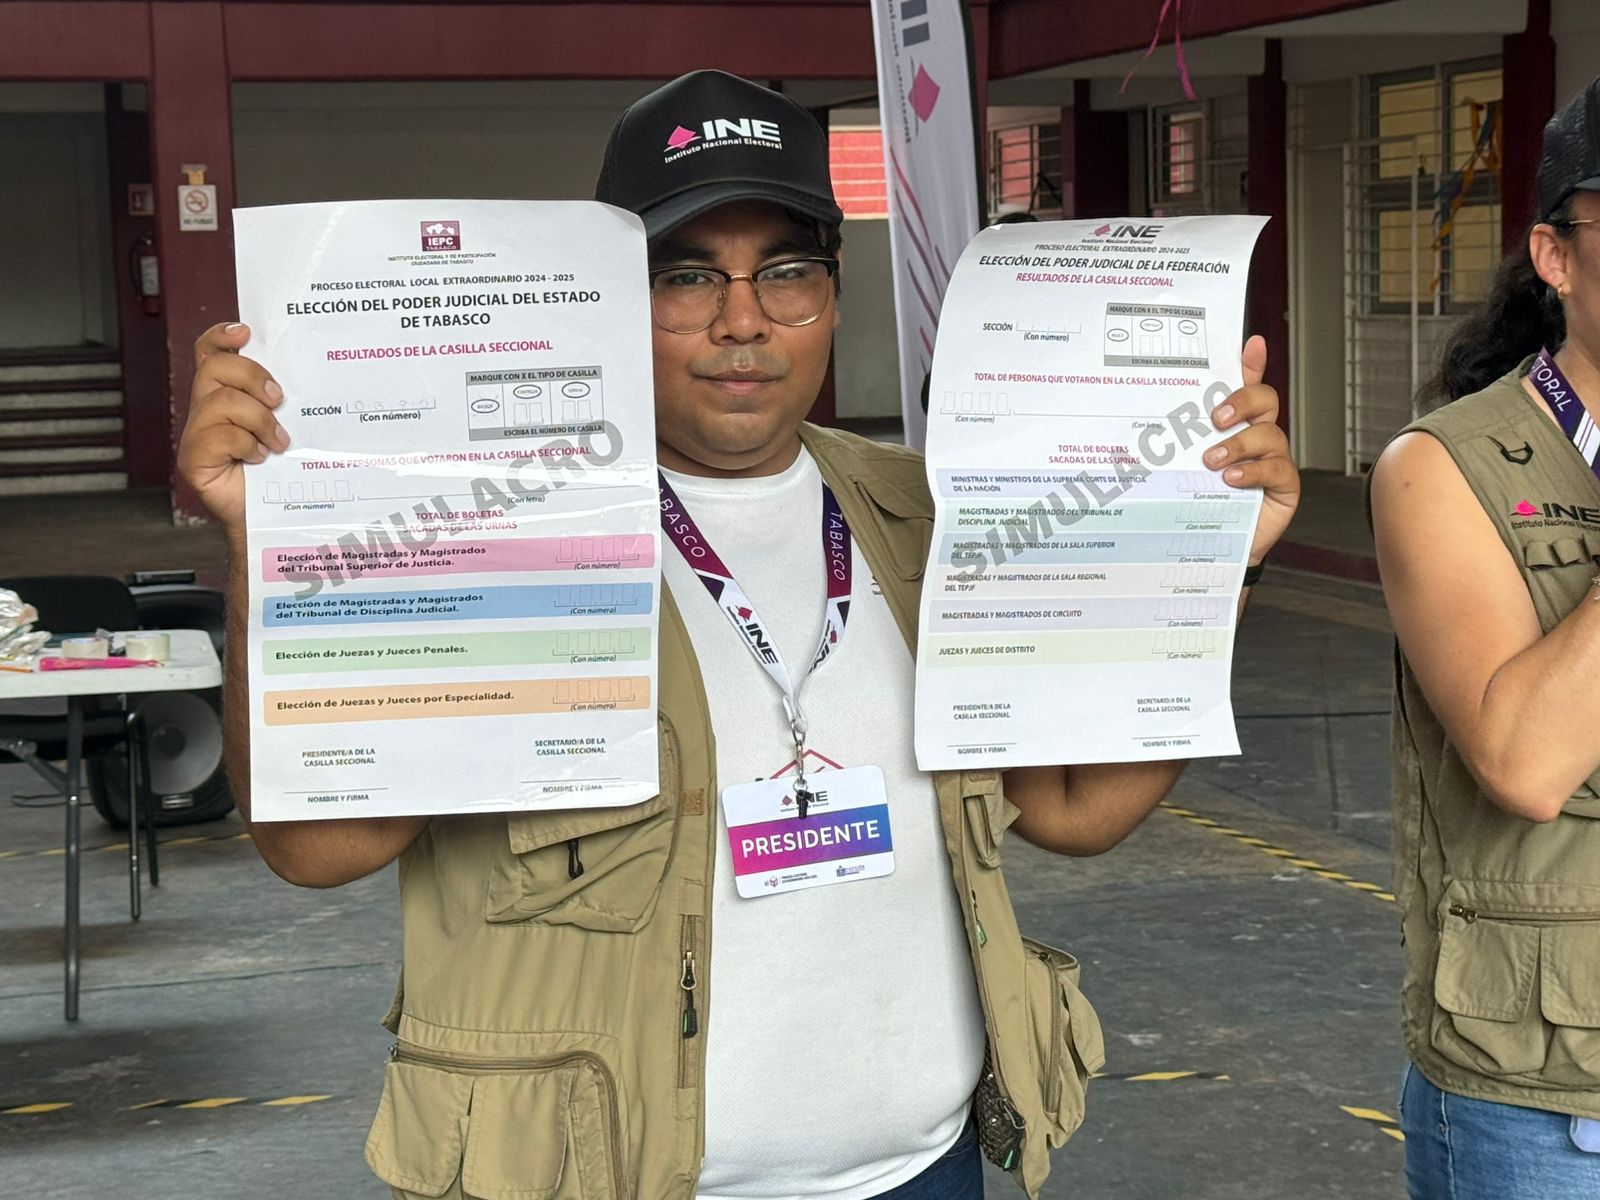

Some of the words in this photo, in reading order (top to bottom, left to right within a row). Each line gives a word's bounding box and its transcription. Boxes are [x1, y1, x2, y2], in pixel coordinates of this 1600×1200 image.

[702, 118, 781, 141] INE
[664, 145, 701, 164] Instituto
[702, 138, 742, 150] Nacional
[743, 137, 782, 150] Electoral
[1111, 226, 1164, 238] INE
[428, 237, 453, 246] IEPC
[979, 256, 1030, 266] ELECCIÓN
[1032, 258, 1050, 267] DEL
[1053, 259, 1088, 268] PODER
[1089, 260, 1134, 270] JUDICIAL
[1136, 261, 1151, 271] DE
[1152, 262, 1164, 271] LA
[1166, 261, 1230, 274] FEDERACIÓN
[311, 282, 353, 291] PROCESO
[355, 280, 406, 289] ELECTORAL
[410, 279, 439, 287] LOCAL
[443, 276, 522, 286] EXTRAORDINARIO
[525, 275, 546, 283] 2024
[553, 274, 574, 282] 2025
[1016, 273, 1070, 282] RESULTADOS
[1070, 275, 1081, 283] DE
[1083, 276, 1094, 284] LA
[1095, 276, 1127, 285] CASILLA
[1129, 277, 1174, 286] SECCIONAL
[287, 300, 357, 315] ELECCIÓN
[362, 300, 388, 312] DEL
[393, 298, 441, 310] PODER
[445, 295, 508, 308] JUDICIAL
[513, 294, 539, 306] DEL
[544, 291, 600, 304] ESTADO
[401, 316, 419, 328] DE
[423, 313, 490, 327] TABASCO
[983, 322, 1013, 331] SECCIÓN
[1024, 333, 1039, 341] (Con
[1040, 333, 1069, 342] número)
[327, 348, 401, 361] RESULTADOS
[404, 347, 420, 357] DE
[422, 346, 437, 356] LA
[440, 344, 486, 355] CASILLA
[489, 341, 553, 353] SECCIONAL
[471, 374, 502, 382] MARQUE
[974, 373, 996, 381] TOTAL
[1008, 374, 1046, 382] PERSONAS
[1048, 375, 1063, 383] QUE
[1065, 376, 1101, 384] VOTARON
[1159, 378, 1200, 386] SECCIONAL
[301, 405, 341, 416] SECCIÓN
[360, 413, 380, 423] (Con
[382, 411, 421, 422] número)
[1058, 445, 1082, 453] TOTAL
[302, 461, 331, 470] TOTAL
[333, 460, 345, 468] DE
[399, 456, 420, 464] QUE
[421, 454, 466, 463] VOTARON
[469, 453, 482, 461] EN
[484, 452, 495, 460] LA
[498, 450, 536, 459] CASILLA
[539, 447, 591, 457] SECCIONAL
[1049, 456, 1085, 464] SACADAS
[284, 503, 301, 511] (Con
[303, 502, 335, 510] número)
[284, 420, 623, 600] SIMULACRO
[1541, 502, 1600, 523] INE
[416, 512, 445, 520] TOTAL
[462, 510, 504, 519] BOLETAS
[829, 512, 846, 581] TABASCO
[278, 553, 322, 562] Elección
[325, 552, 339, 560] de
[341, 550, 408, 562] Magistradas
[411, 549, 417, 559] y
[420, 546, 486, 558] Magistrados
[278, 565, 295, 573] del
[299, 563, 343, 572] Tribunal
[346, 561, 393, 572] Superior
[396, 560, 409, 568] de
[411, 558, 454, 568] Justicia.
[591, 562, 620, 570] número)
[276, 600, 320, 610] Elección
[323, 600, 337, 608] de
[340, 597, 406, 609] Magistradas
[409, 597, 415, 606] y
[417, 594, 483, 606] Magistrados
[276, 611, 293, 619] del
[296, 609, 341, 618] Tribunal
[360, 607, 413, 618] Disciplina
[416, 605, 459, 614] Judicial.
[570, 607, 586, 615] (Con
[745, 622, 779, 665] INE
[276, 651, 320, 660] Elección
[323, 650, 336, 658] de
[339, 649, 374, 657] Juezas
[377, 649, 383, 658] y
[386, 647, 421, 656] Jueces
[424, 646, 468, 654] Penales.
[571, 656, 586, 664] (Con
[588, 655, 616, 663] número)
[277, 700, 321, 709] Elección
[324, 700, 337, 708] de
[340, 698, 375, 707] Juezas
[378, 698, 384, 707] y
[387, 696, 422, 705] Jueces
[424, 695, 442, 705] por
[445, 692, 514, 704] Especialidad.
[535, 739, 584, 747] SECRETARIO/A
[302, 750, 353, 758] PRESIDENTE/A
[304, 759, 334, 767] CASILLA
[741, 819, 880, 858] PRESIDENTE
